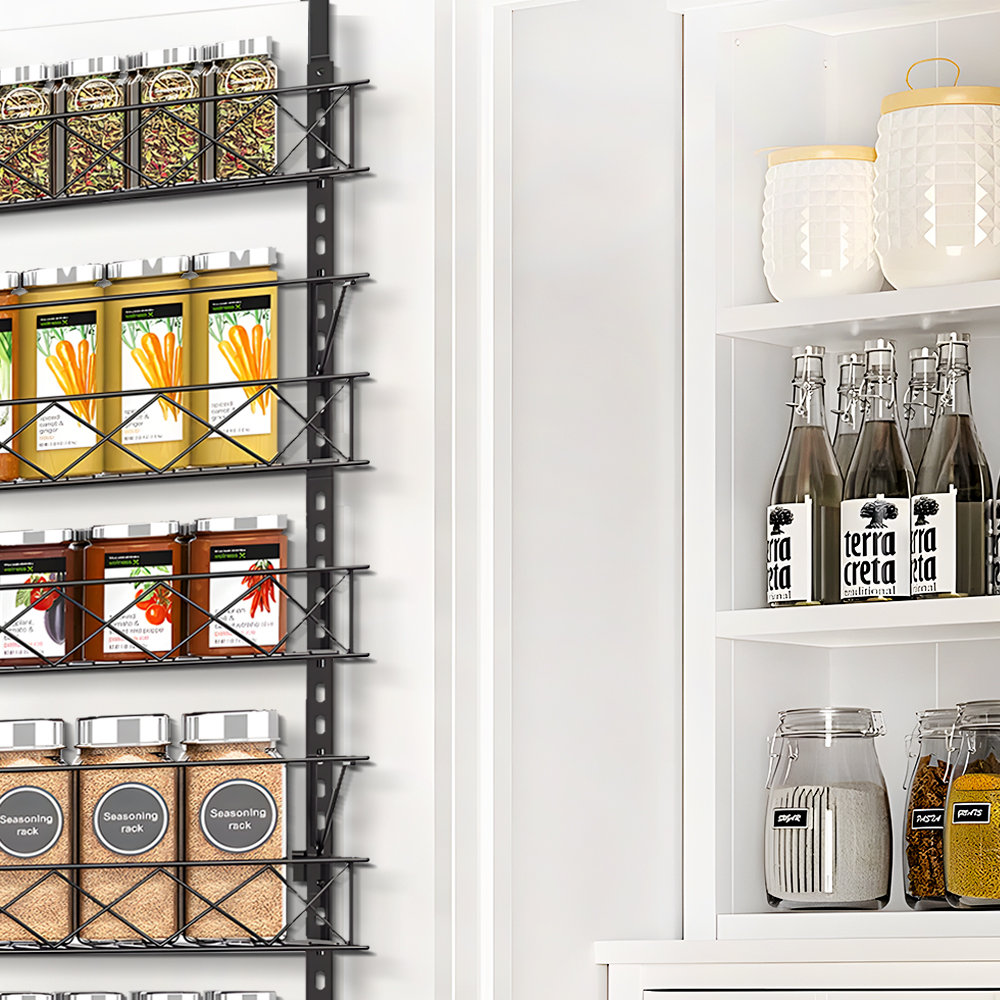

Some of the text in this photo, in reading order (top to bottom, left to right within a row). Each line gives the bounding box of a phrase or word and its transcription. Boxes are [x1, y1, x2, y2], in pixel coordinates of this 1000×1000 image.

[844, 531, 896, 558] terra
[844, 559, 896, 586] creta
[103, 811, 159, 822] Seasoning
[209, 808, 267, 819] Seasoning
[0, 814, 53, 825] Seasoning
[16, 826, 39, 836] rack
[121, 823, 144, 834] rack
[228, 821, 252, 831] rack
